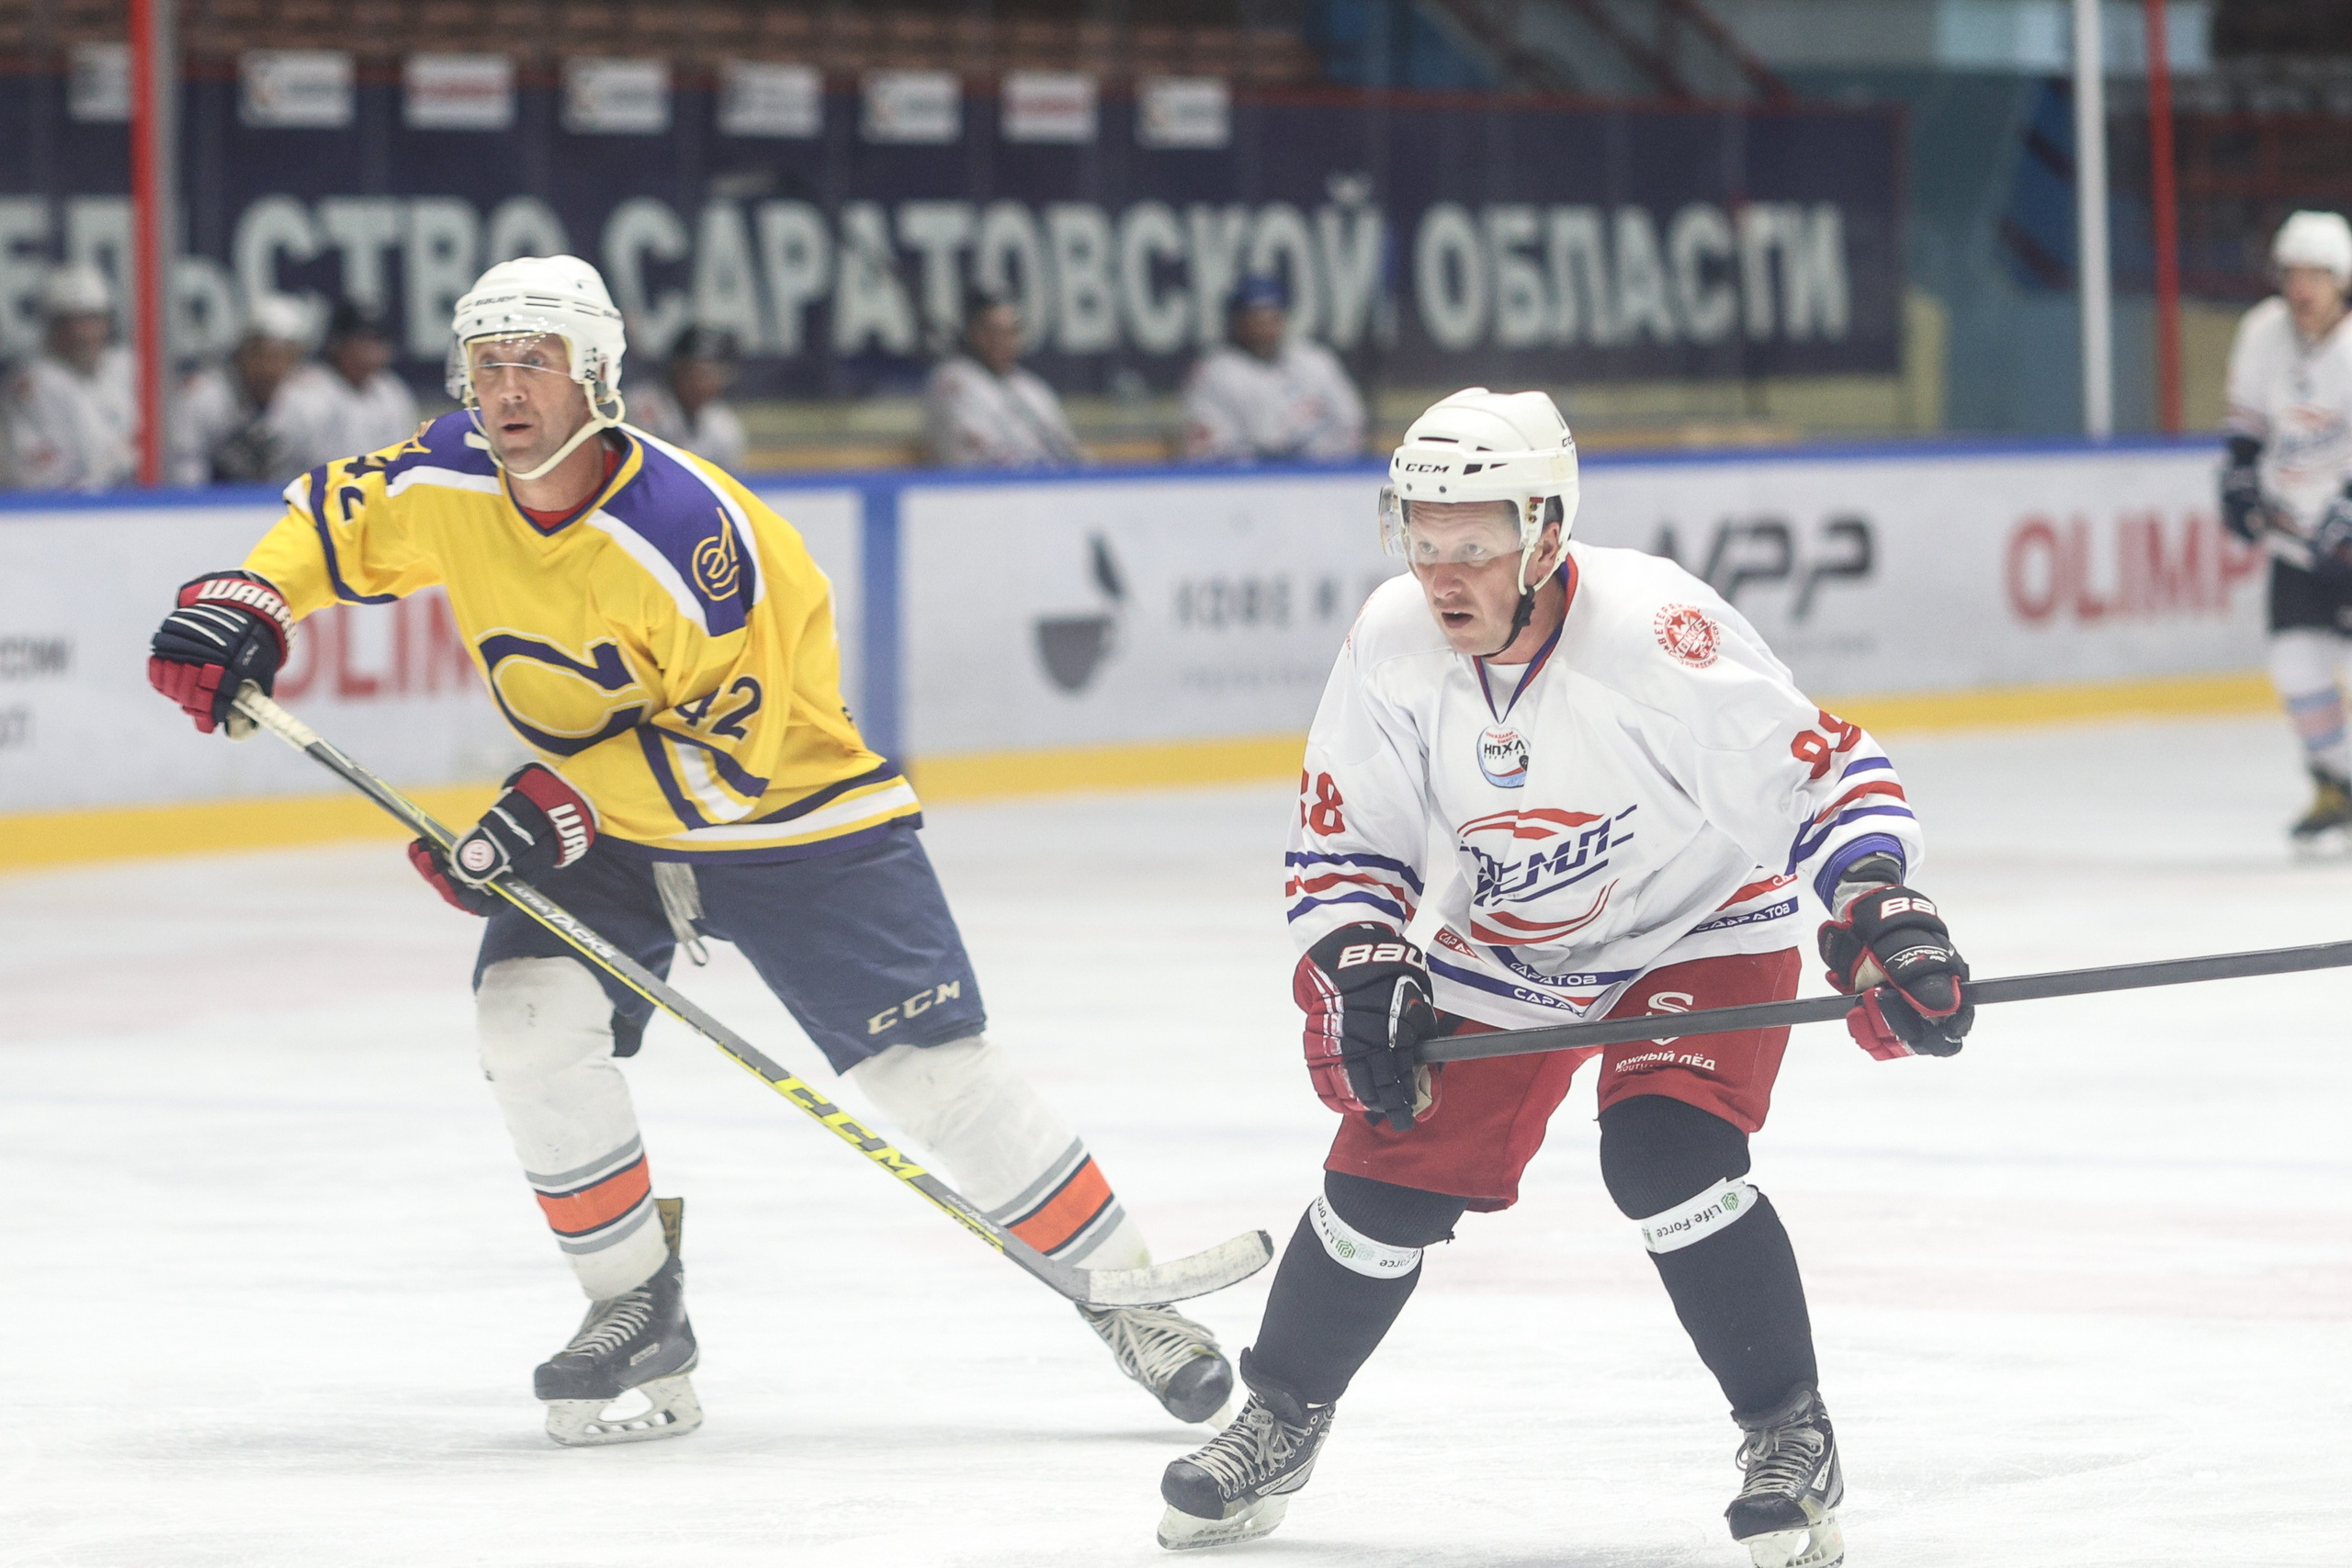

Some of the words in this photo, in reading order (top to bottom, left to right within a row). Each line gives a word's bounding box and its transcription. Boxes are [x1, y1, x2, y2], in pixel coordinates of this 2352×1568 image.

[602, 171, 1381, 358] САРАТОВСКОЙ
[1416, 197, 1851, 355] ОБЛАСТИ
[1405, 462, 1450, 473] CCM
[1484, 739, 1525, 755] НПХЛ
[866, 979, 961, 1035] CCM
[1615, 1050, 1676, 1072] ЮЖНЫЙ
[1678, 1053, 1716, 1071] ЛЁД
[774, 1073, 929, 1182] CCM
[1694, 1204, 1723, 1224] Life
[1657, 1218, 1691, 1237] Force
